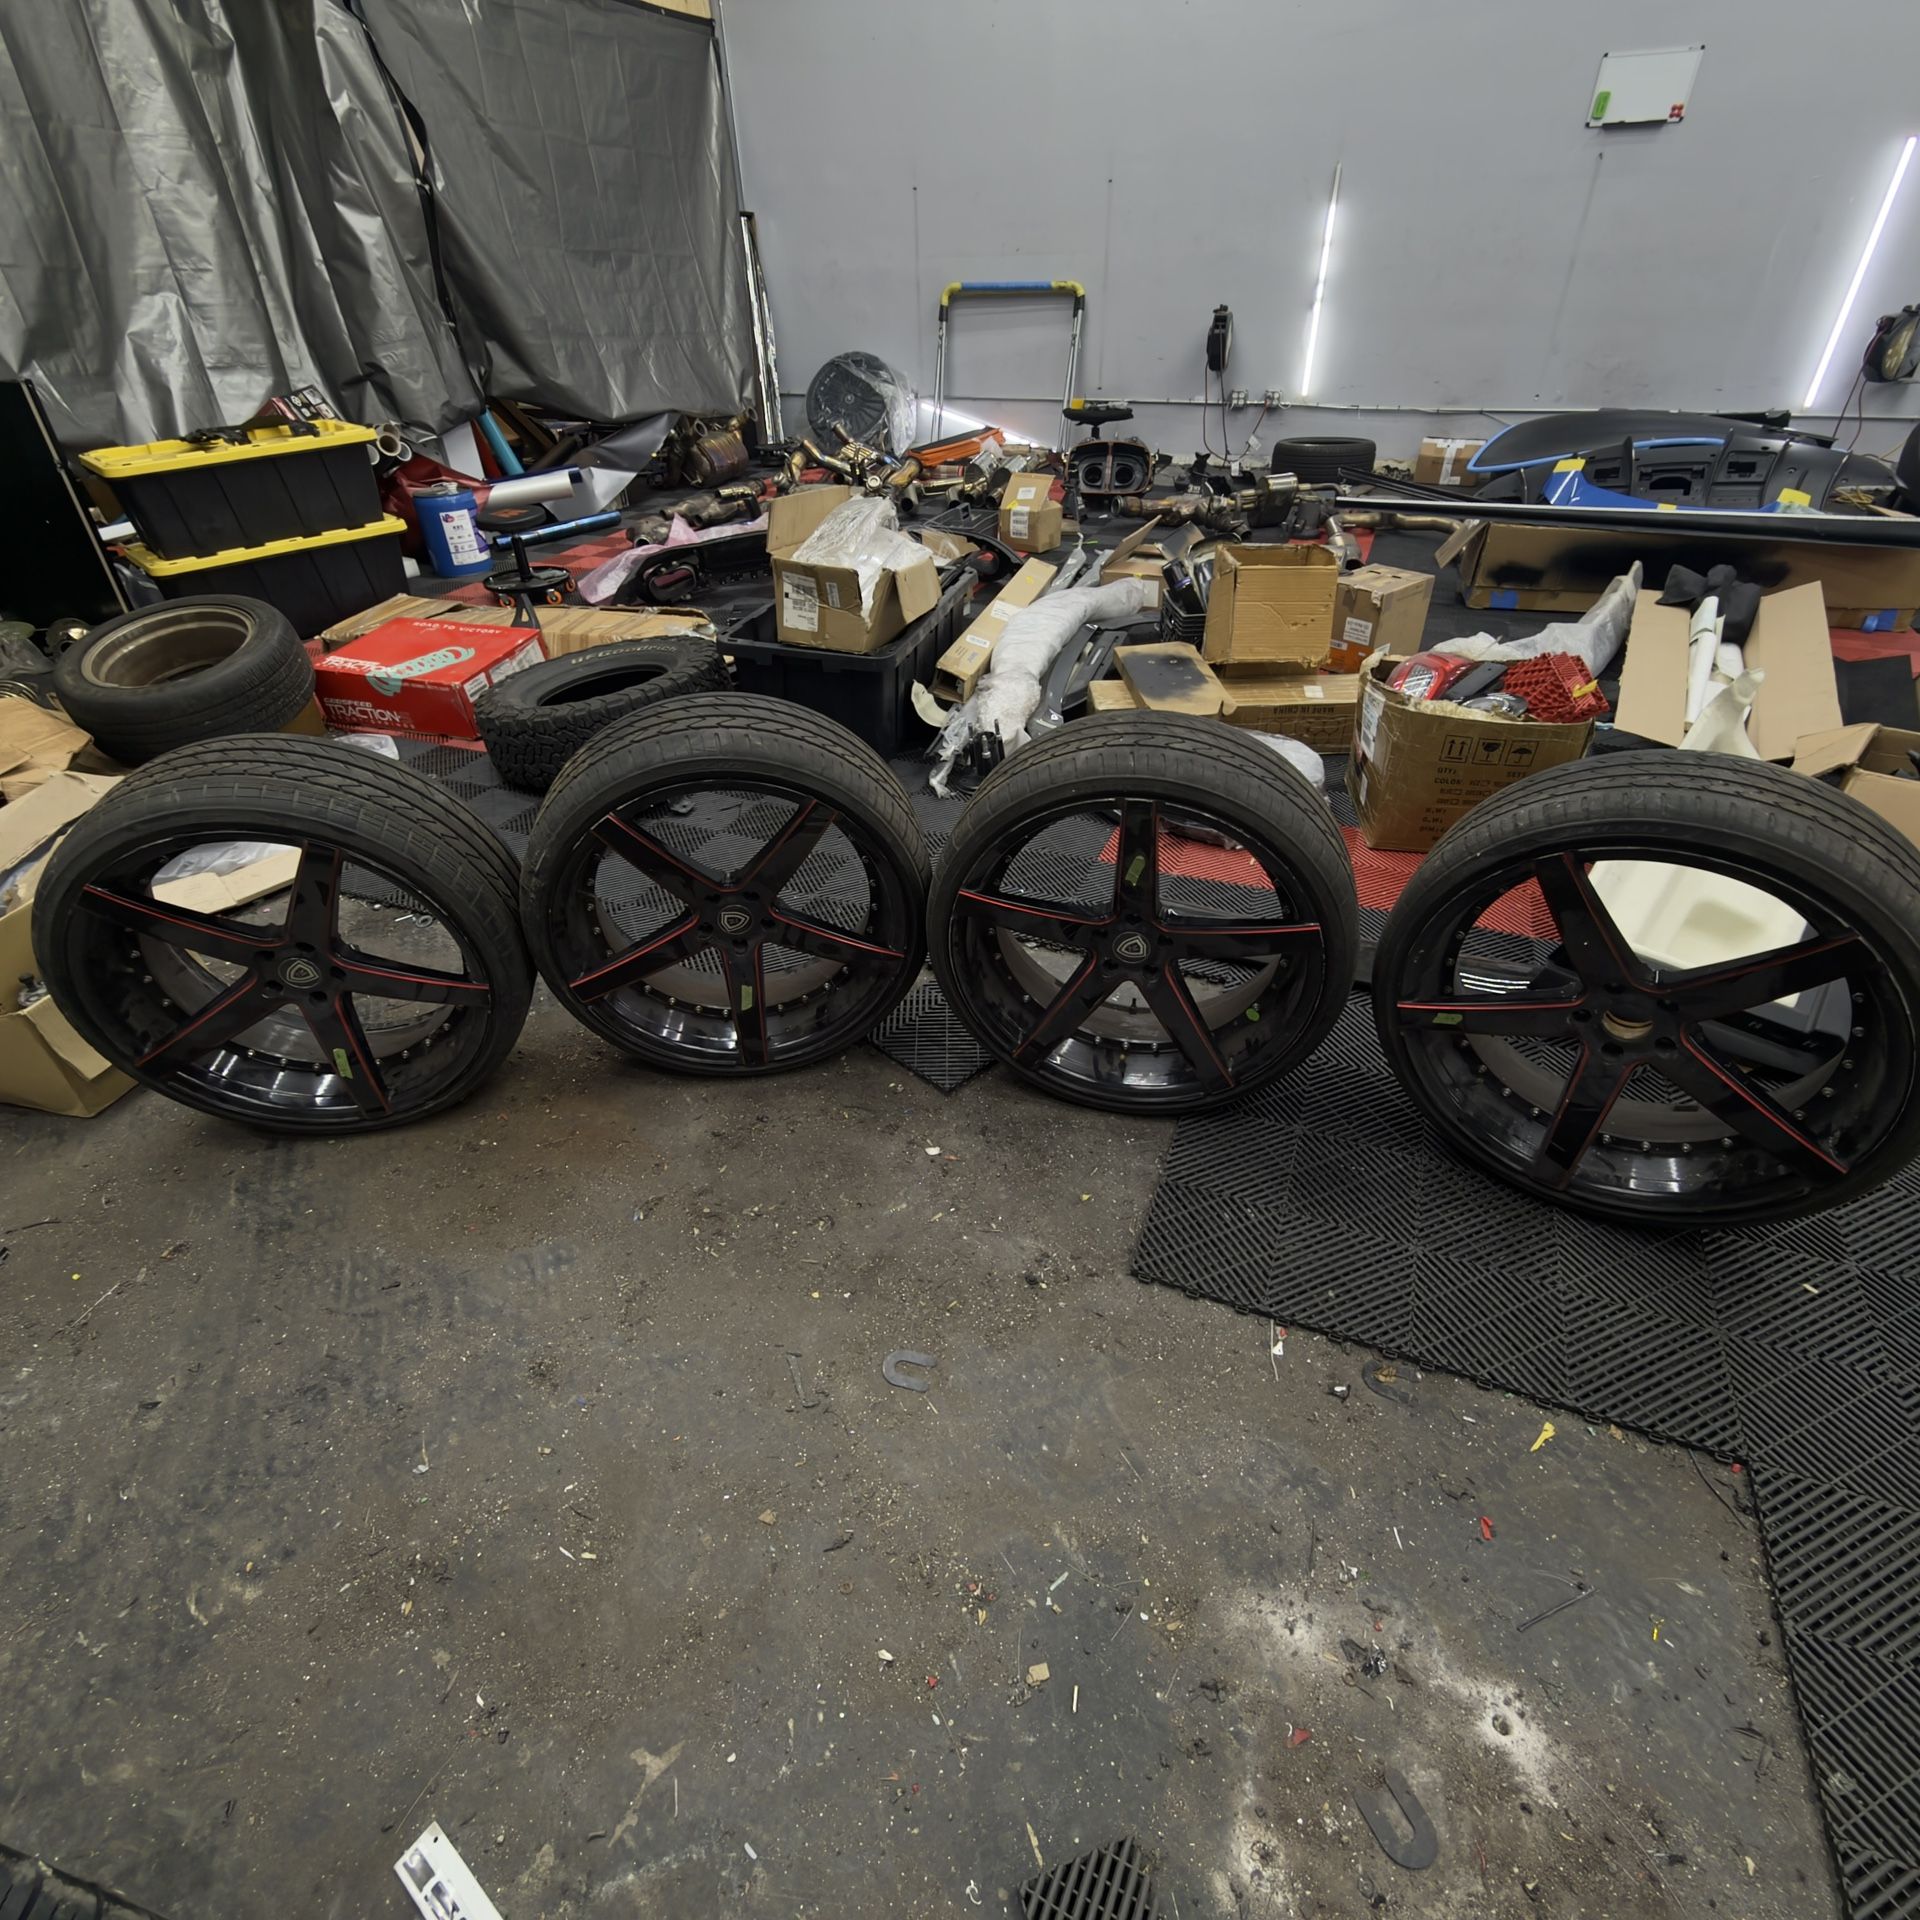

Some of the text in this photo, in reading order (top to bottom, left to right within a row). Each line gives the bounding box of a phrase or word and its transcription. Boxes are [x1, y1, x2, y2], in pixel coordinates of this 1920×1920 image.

[412, 621, 503, 635] ROAD TO VICTORY
[1273, 706, 1298, 714] CHINA
